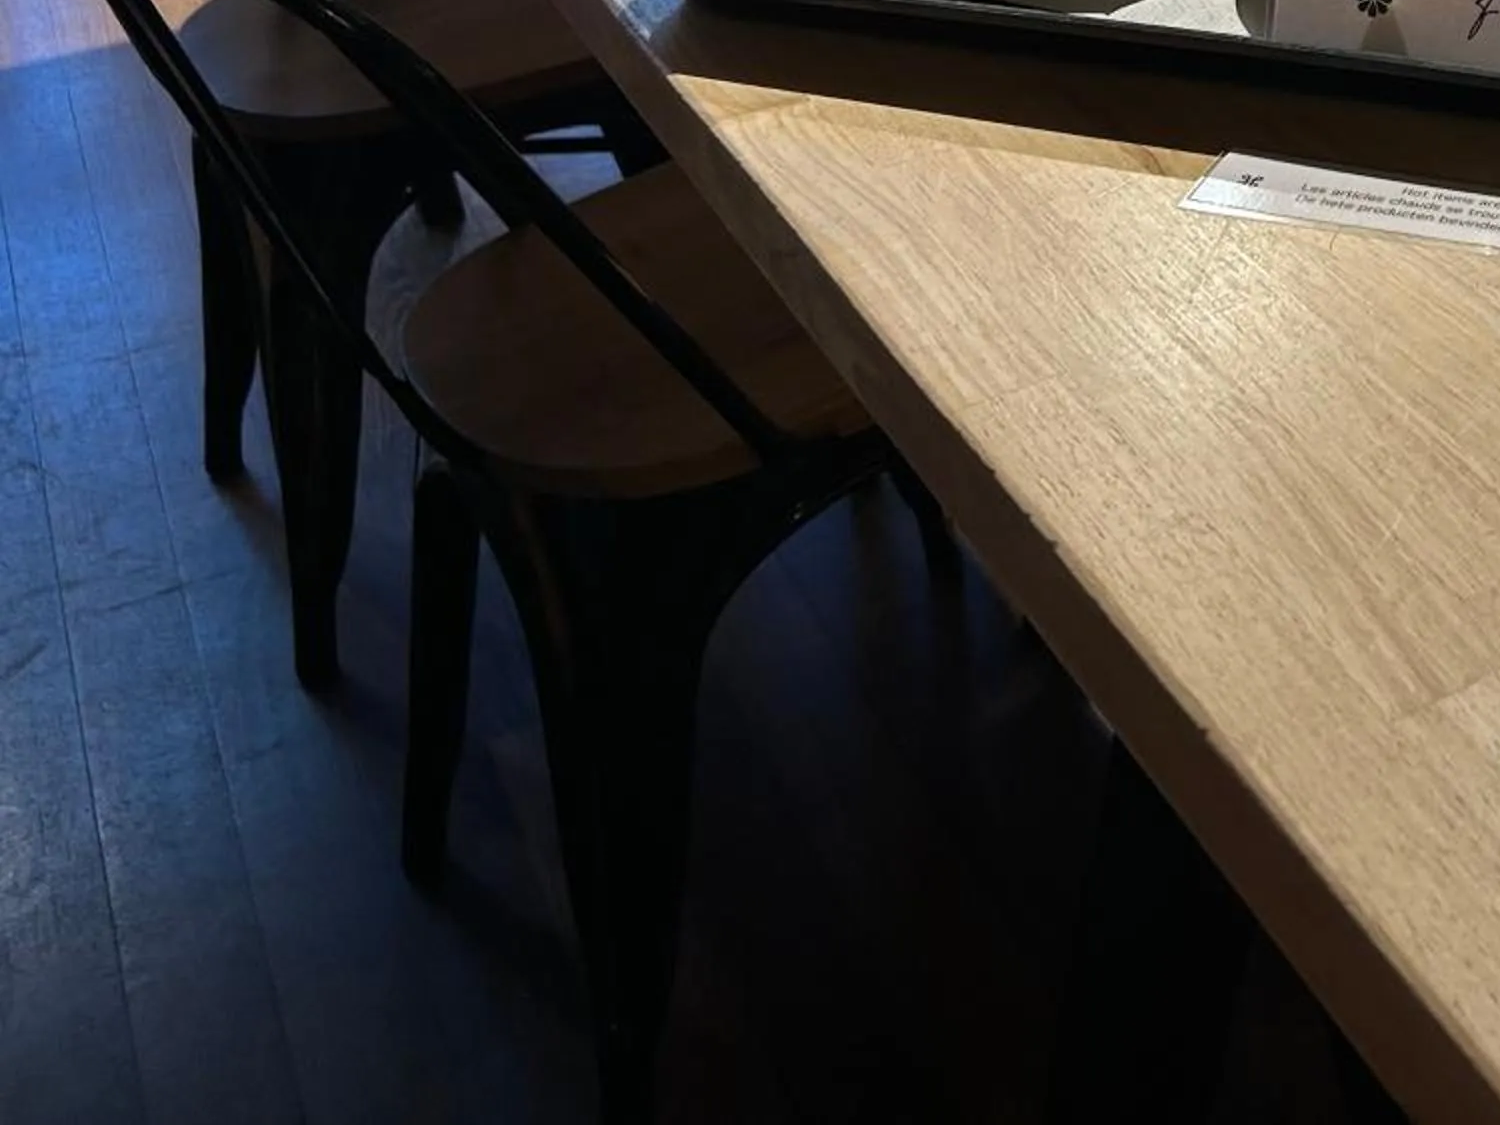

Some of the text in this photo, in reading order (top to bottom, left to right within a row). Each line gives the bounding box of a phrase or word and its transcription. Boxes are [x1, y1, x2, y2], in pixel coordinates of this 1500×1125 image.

[1295, 194, 1317, 203] De
[1319, 196, 1355, 210] hete
[1301, 182, 1327, 194] Les
[1331, 187, 1386, 202] articles
[1389, 197, 1442, 211] chauds
[1446, 205, 1464, 214] se
[1402, 186, 1429, 198] Hot
[1432, 190, 1475, 205] items
